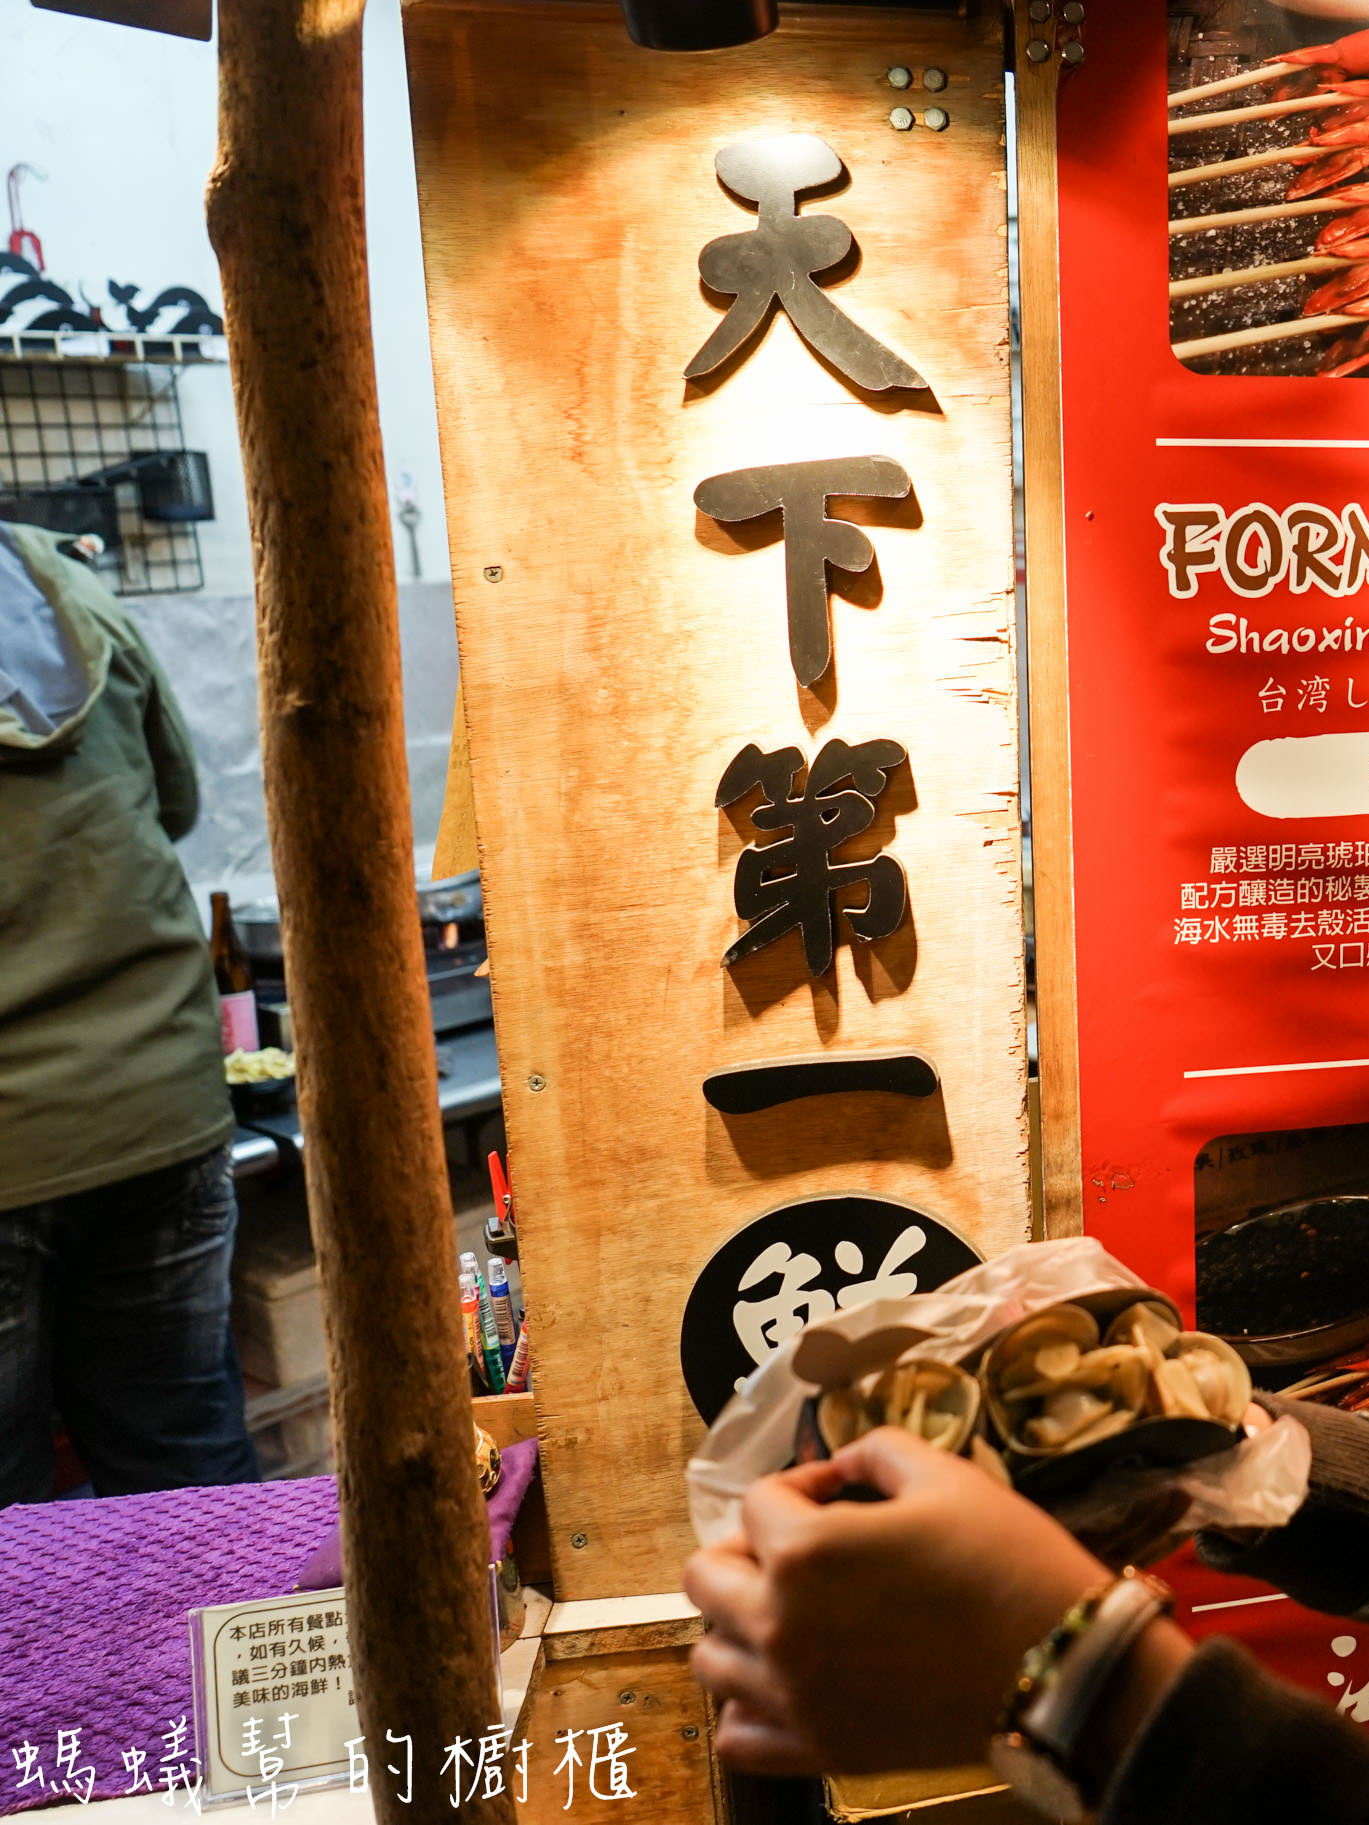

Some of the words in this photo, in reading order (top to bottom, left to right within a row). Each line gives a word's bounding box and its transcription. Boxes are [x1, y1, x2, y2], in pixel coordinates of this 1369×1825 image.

[229, 1611, 349, 1642] 本店所有餐點
[231, 1653, 353, 1687] 議三分鐘內熱
